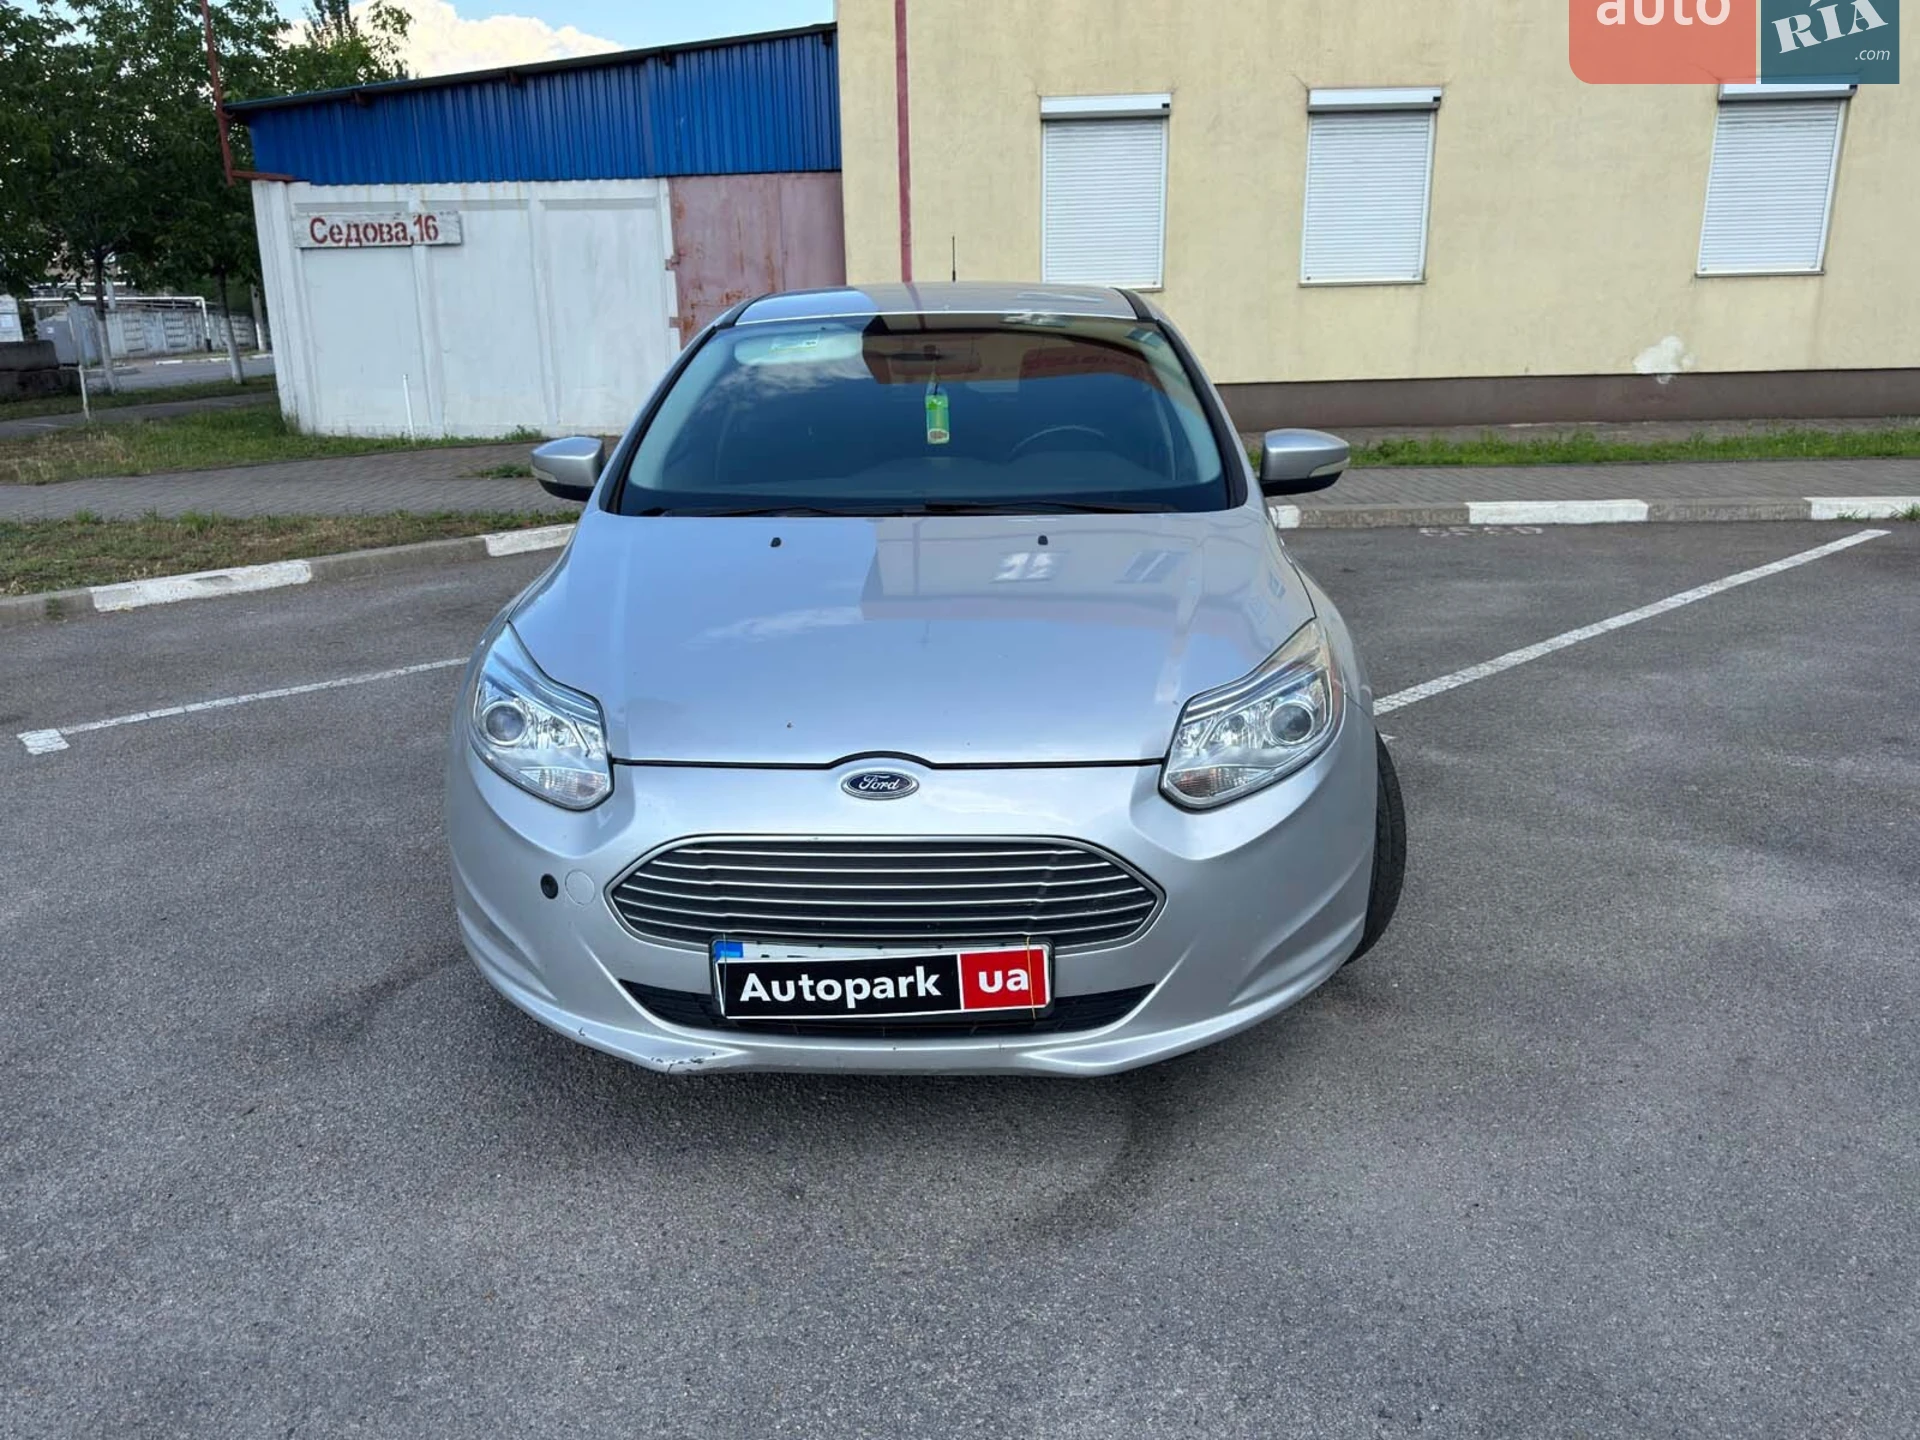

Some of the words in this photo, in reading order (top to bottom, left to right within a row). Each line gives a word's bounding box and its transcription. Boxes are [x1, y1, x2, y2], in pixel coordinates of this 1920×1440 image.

[858, 774, 901, 790] Ford
[739, 966, 942, 1009] Autopark
[978, 968, 1029, 993] ua
